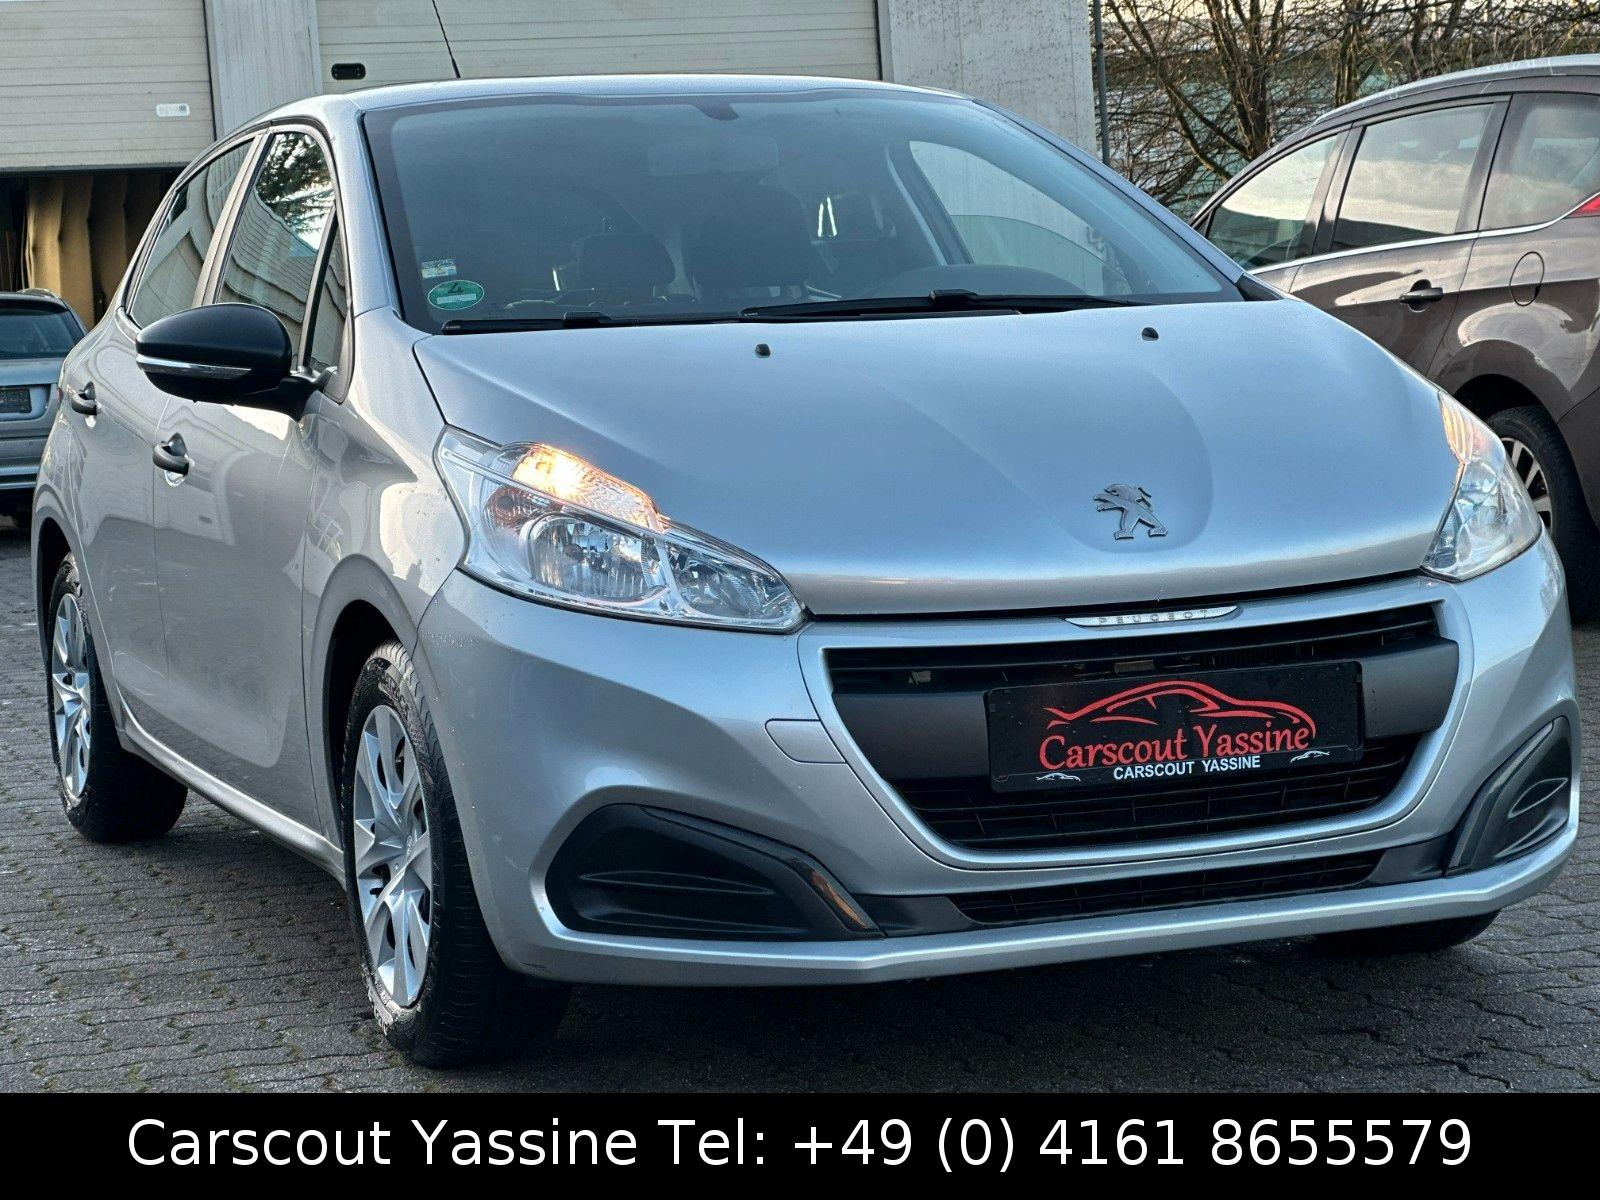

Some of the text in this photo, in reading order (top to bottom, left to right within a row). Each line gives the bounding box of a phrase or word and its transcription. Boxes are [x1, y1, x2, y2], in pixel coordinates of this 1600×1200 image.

[448, 282, 463, 294] 4
[1098, 609, 1208, 624] PEUGEOT
[1039, 720, 1309, 770] Carscout Yassine
[1113, 755, 1262, 780] CARSCOUT YASSINE
